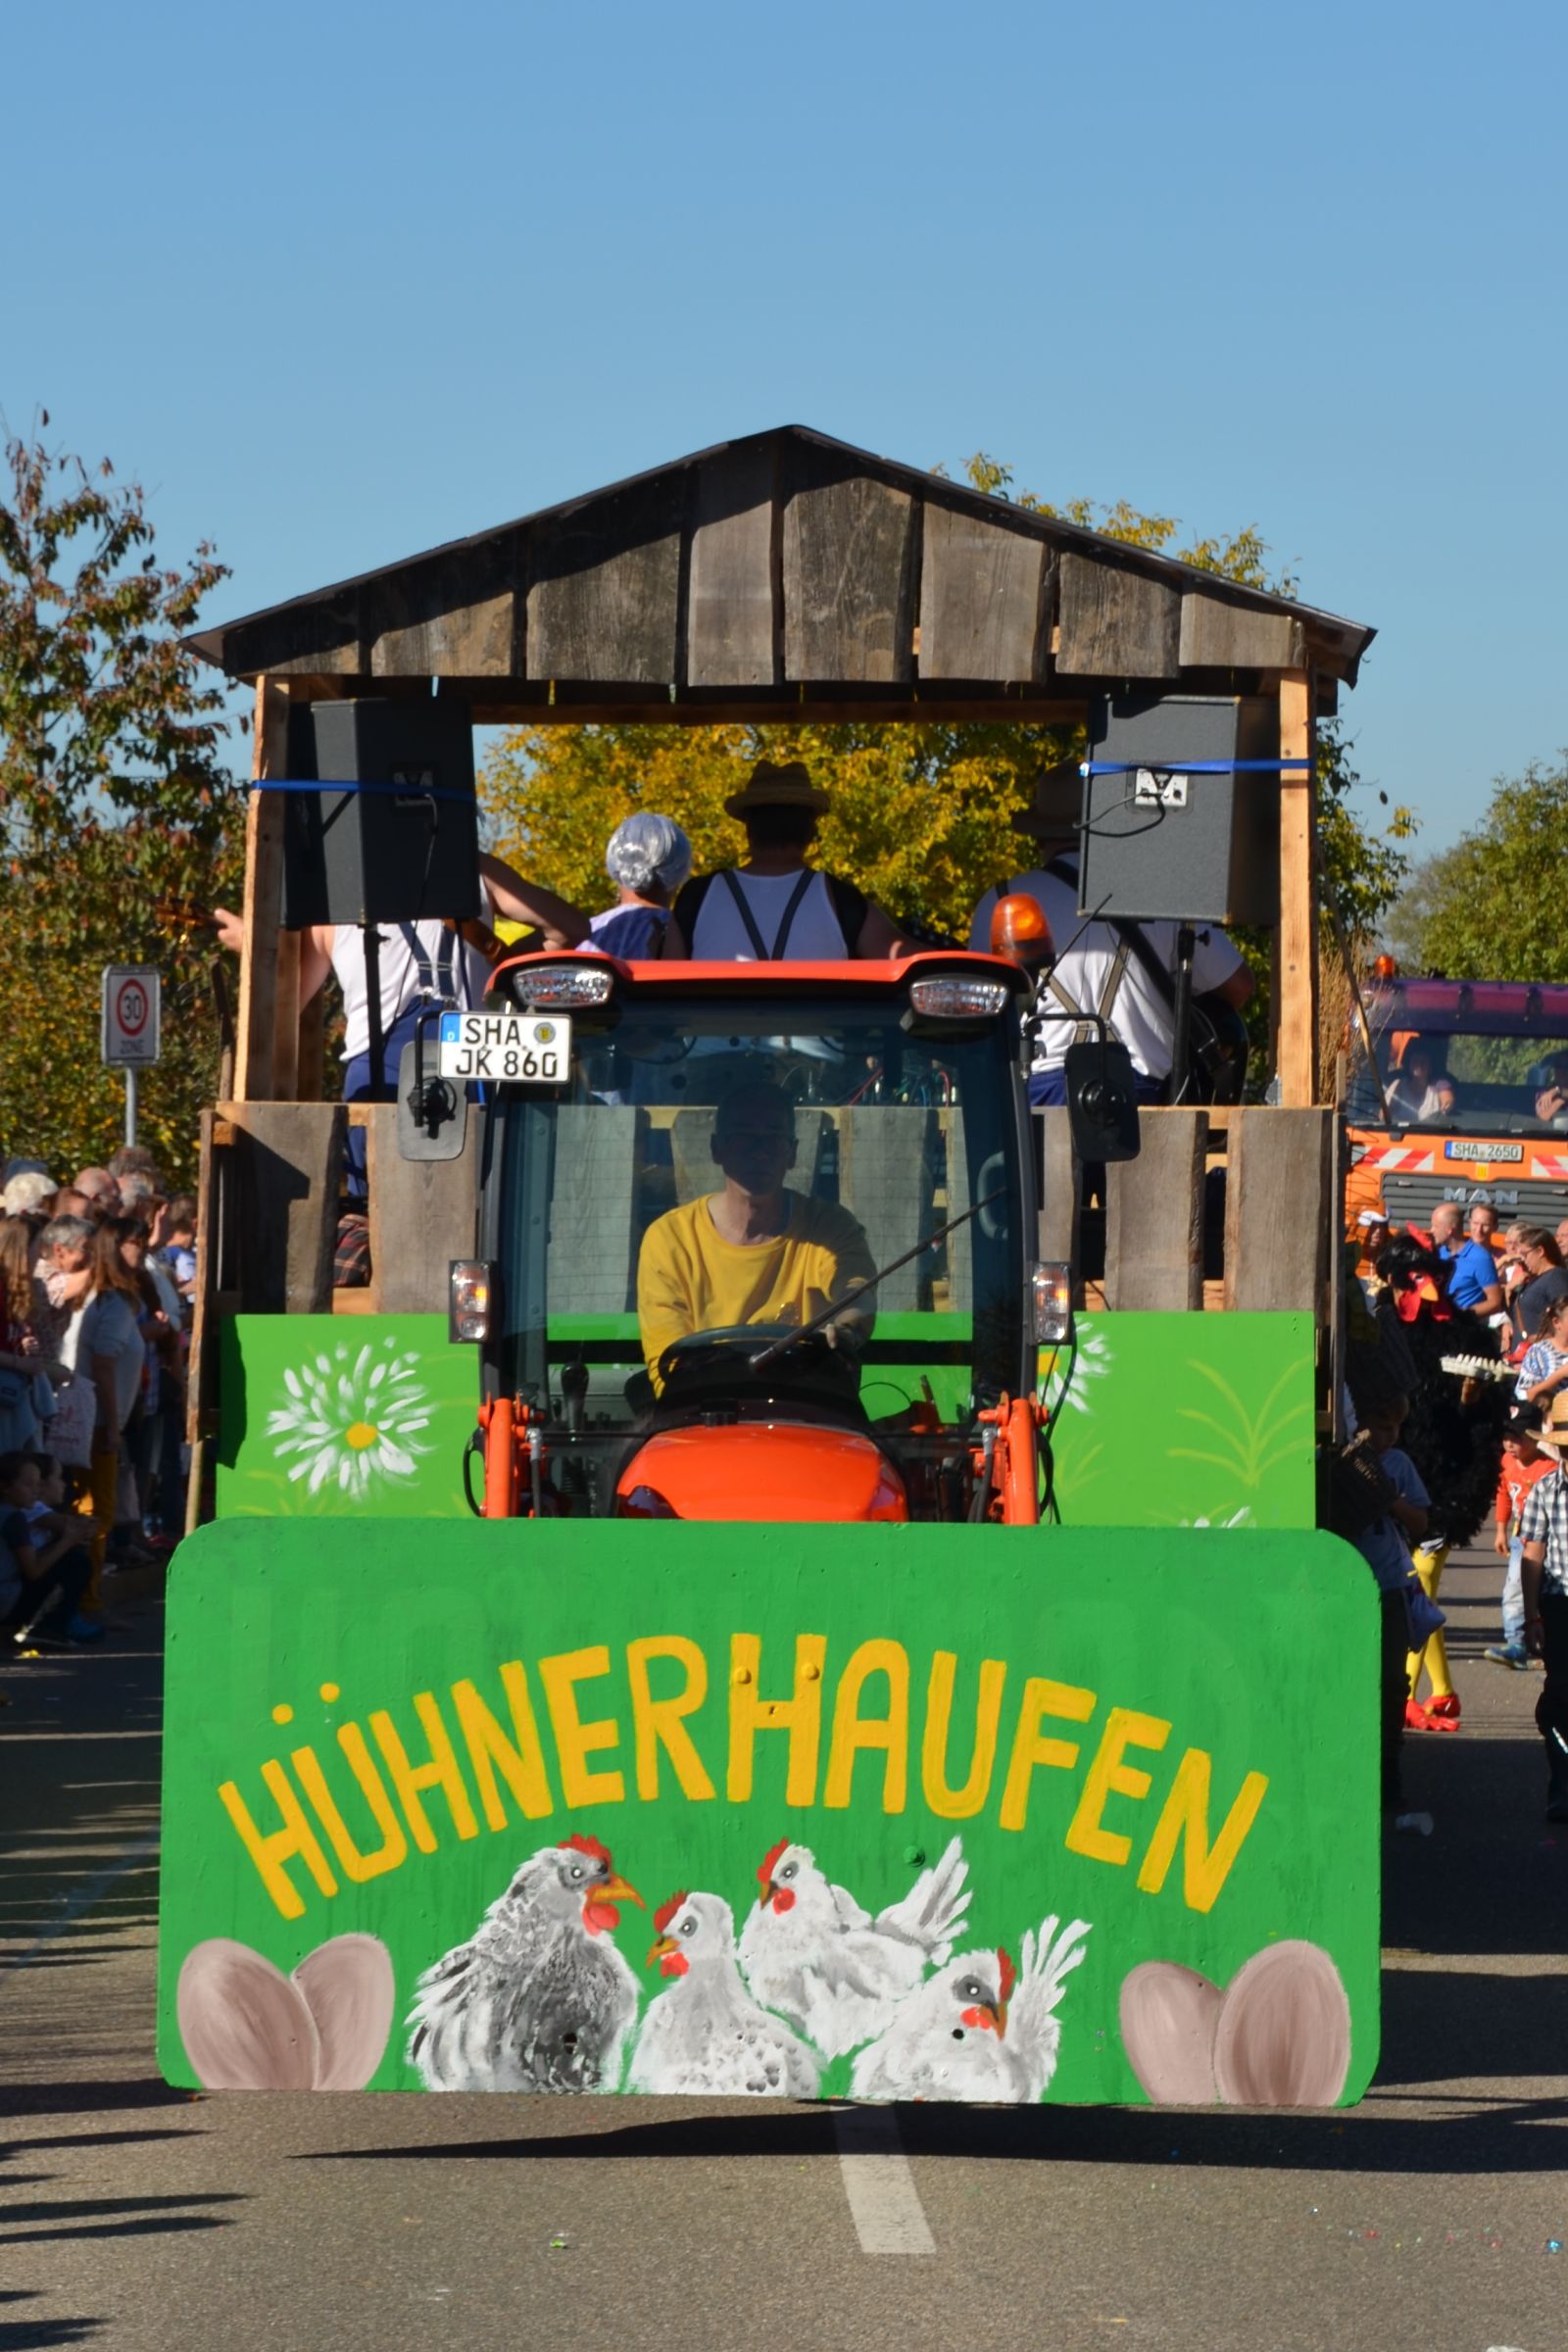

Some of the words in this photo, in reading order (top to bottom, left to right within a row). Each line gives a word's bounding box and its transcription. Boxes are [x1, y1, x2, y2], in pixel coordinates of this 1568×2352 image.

[123, 995, 141, 1020] 30
[447, 1031, 455, 1042] D
[465, 1017, 521, 1046] SHA
[120, 1040, 145, 1054] ZONE
[456, 1049, 492, 1076] JK
[504, 1051, 558, 1078] 860
[1454, 1143, 1479, 1156] SHA
[1488, 1145, 1519, 1159] 2650
[1444, 1187, 1519, 1205] MAN
[218, 1633, 1269, 1920] HÜHNERHAUFEN
